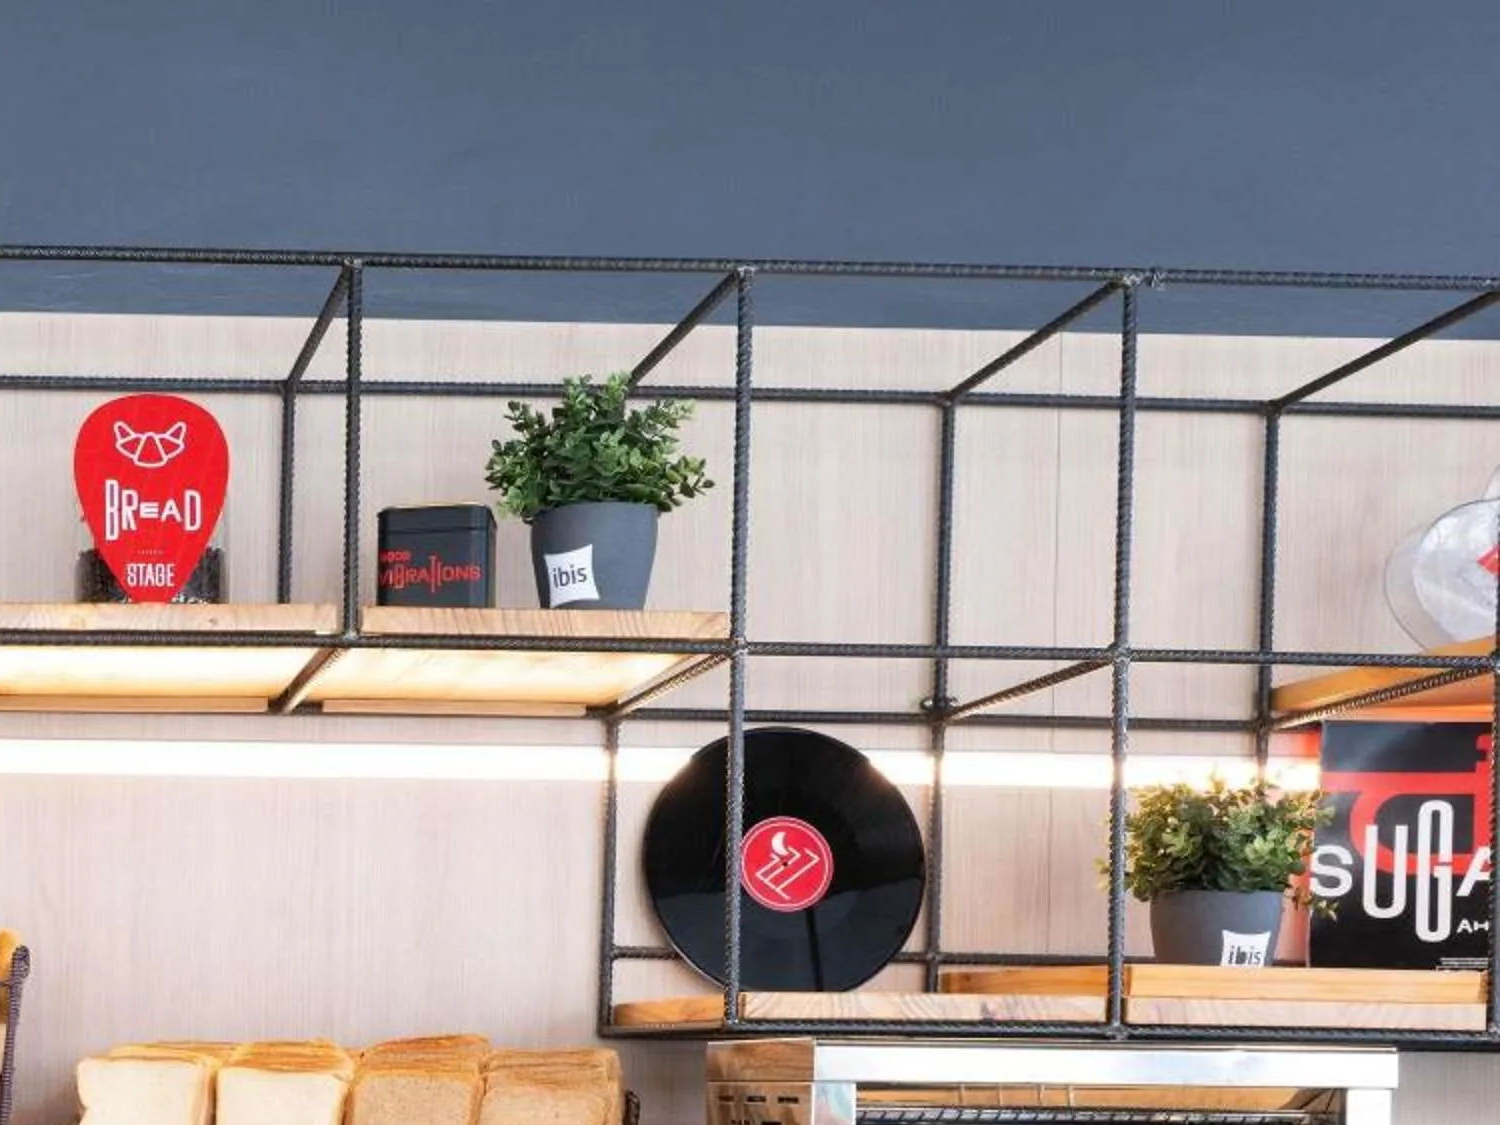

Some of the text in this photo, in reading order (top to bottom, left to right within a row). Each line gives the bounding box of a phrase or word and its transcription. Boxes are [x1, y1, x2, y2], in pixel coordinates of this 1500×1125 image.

[104, 479, 202, 542] BREAD
[127, 563, 175, 587] STAGE
[553, 564, 587, 588] ibis
[1228, 945, 1261, 965] ibis
